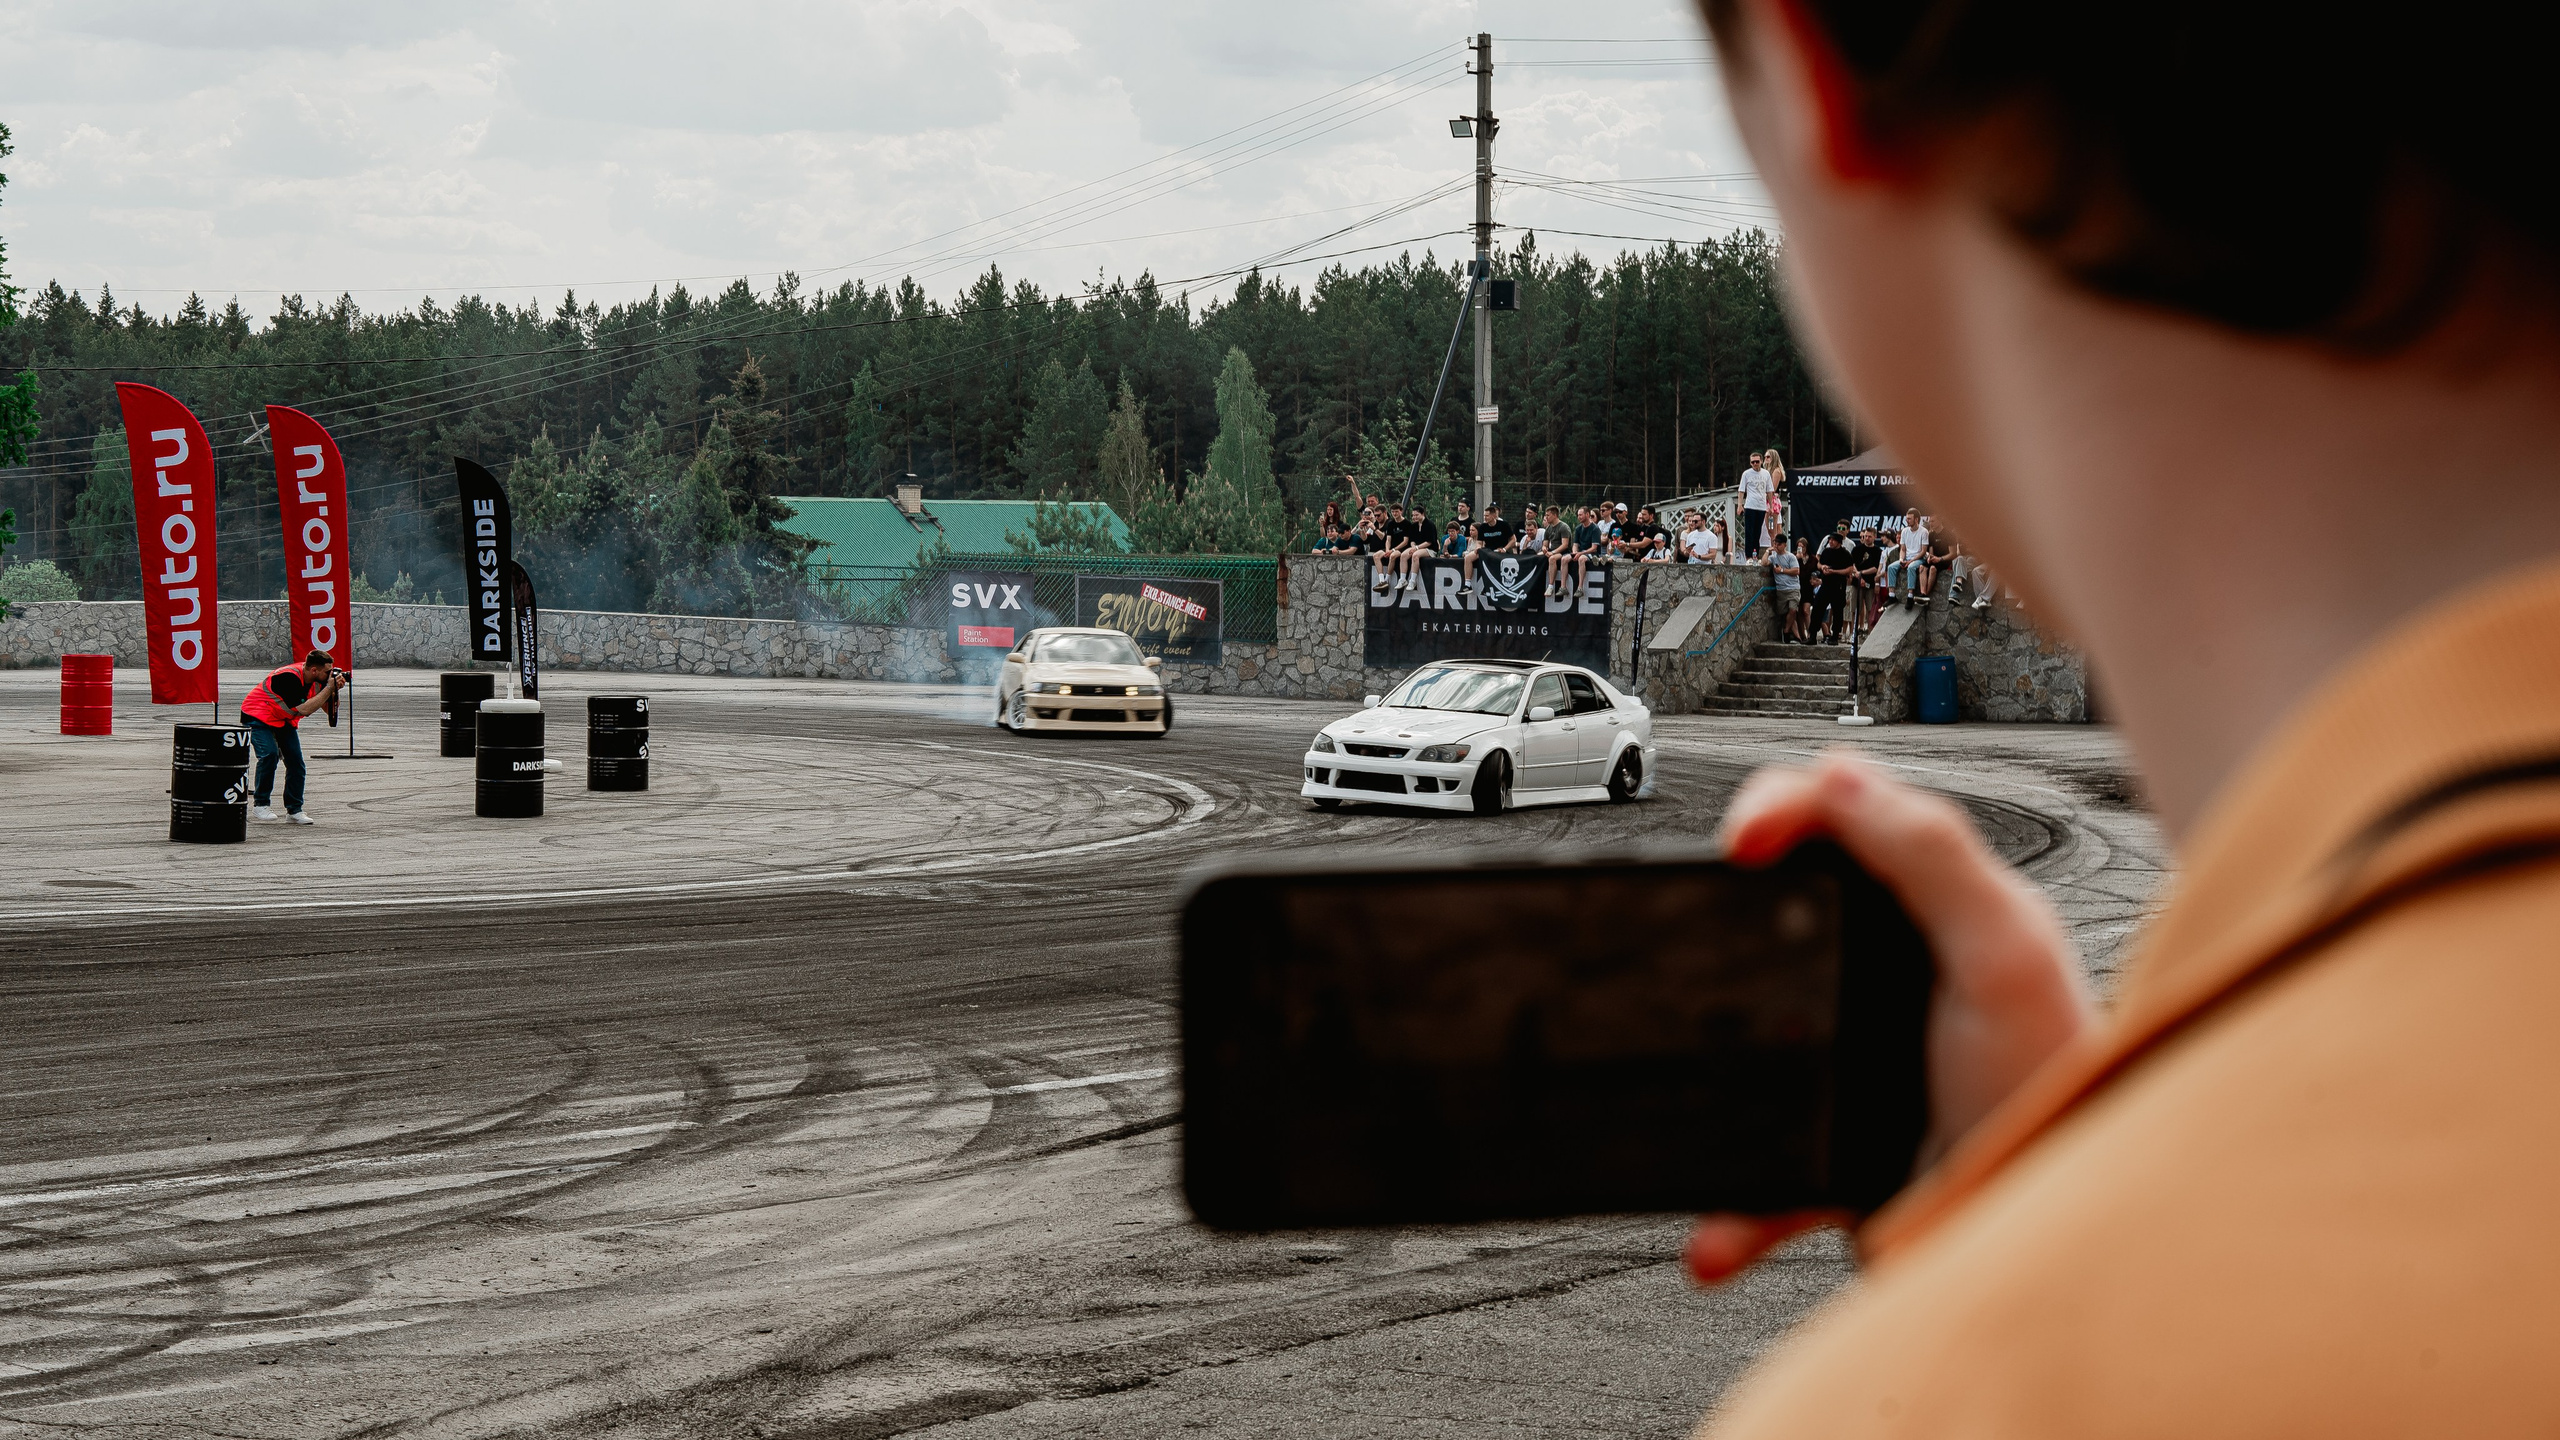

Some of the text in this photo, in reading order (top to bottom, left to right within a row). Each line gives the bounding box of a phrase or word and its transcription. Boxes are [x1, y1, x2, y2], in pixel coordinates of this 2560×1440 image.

[1796, 475, 1861, 486] XPERIENCE
[1863, 475, 1877, 486] BY
[1850, 515, 1880, 532] SIDE
[151, 428, 203, 670] auto.ru
[293, 444, 337, 652] auto.ru
[473, 499, 501, 651] DARKSIDE
[1370, 565, 1605, 615] DARKDE
[952, 583, 1021, 610] SVX
[1421, 622, 1549, 636] EKATERINBURG
[1163, 646, 1192, 656] event
[223, 769, 249, 805] SV
